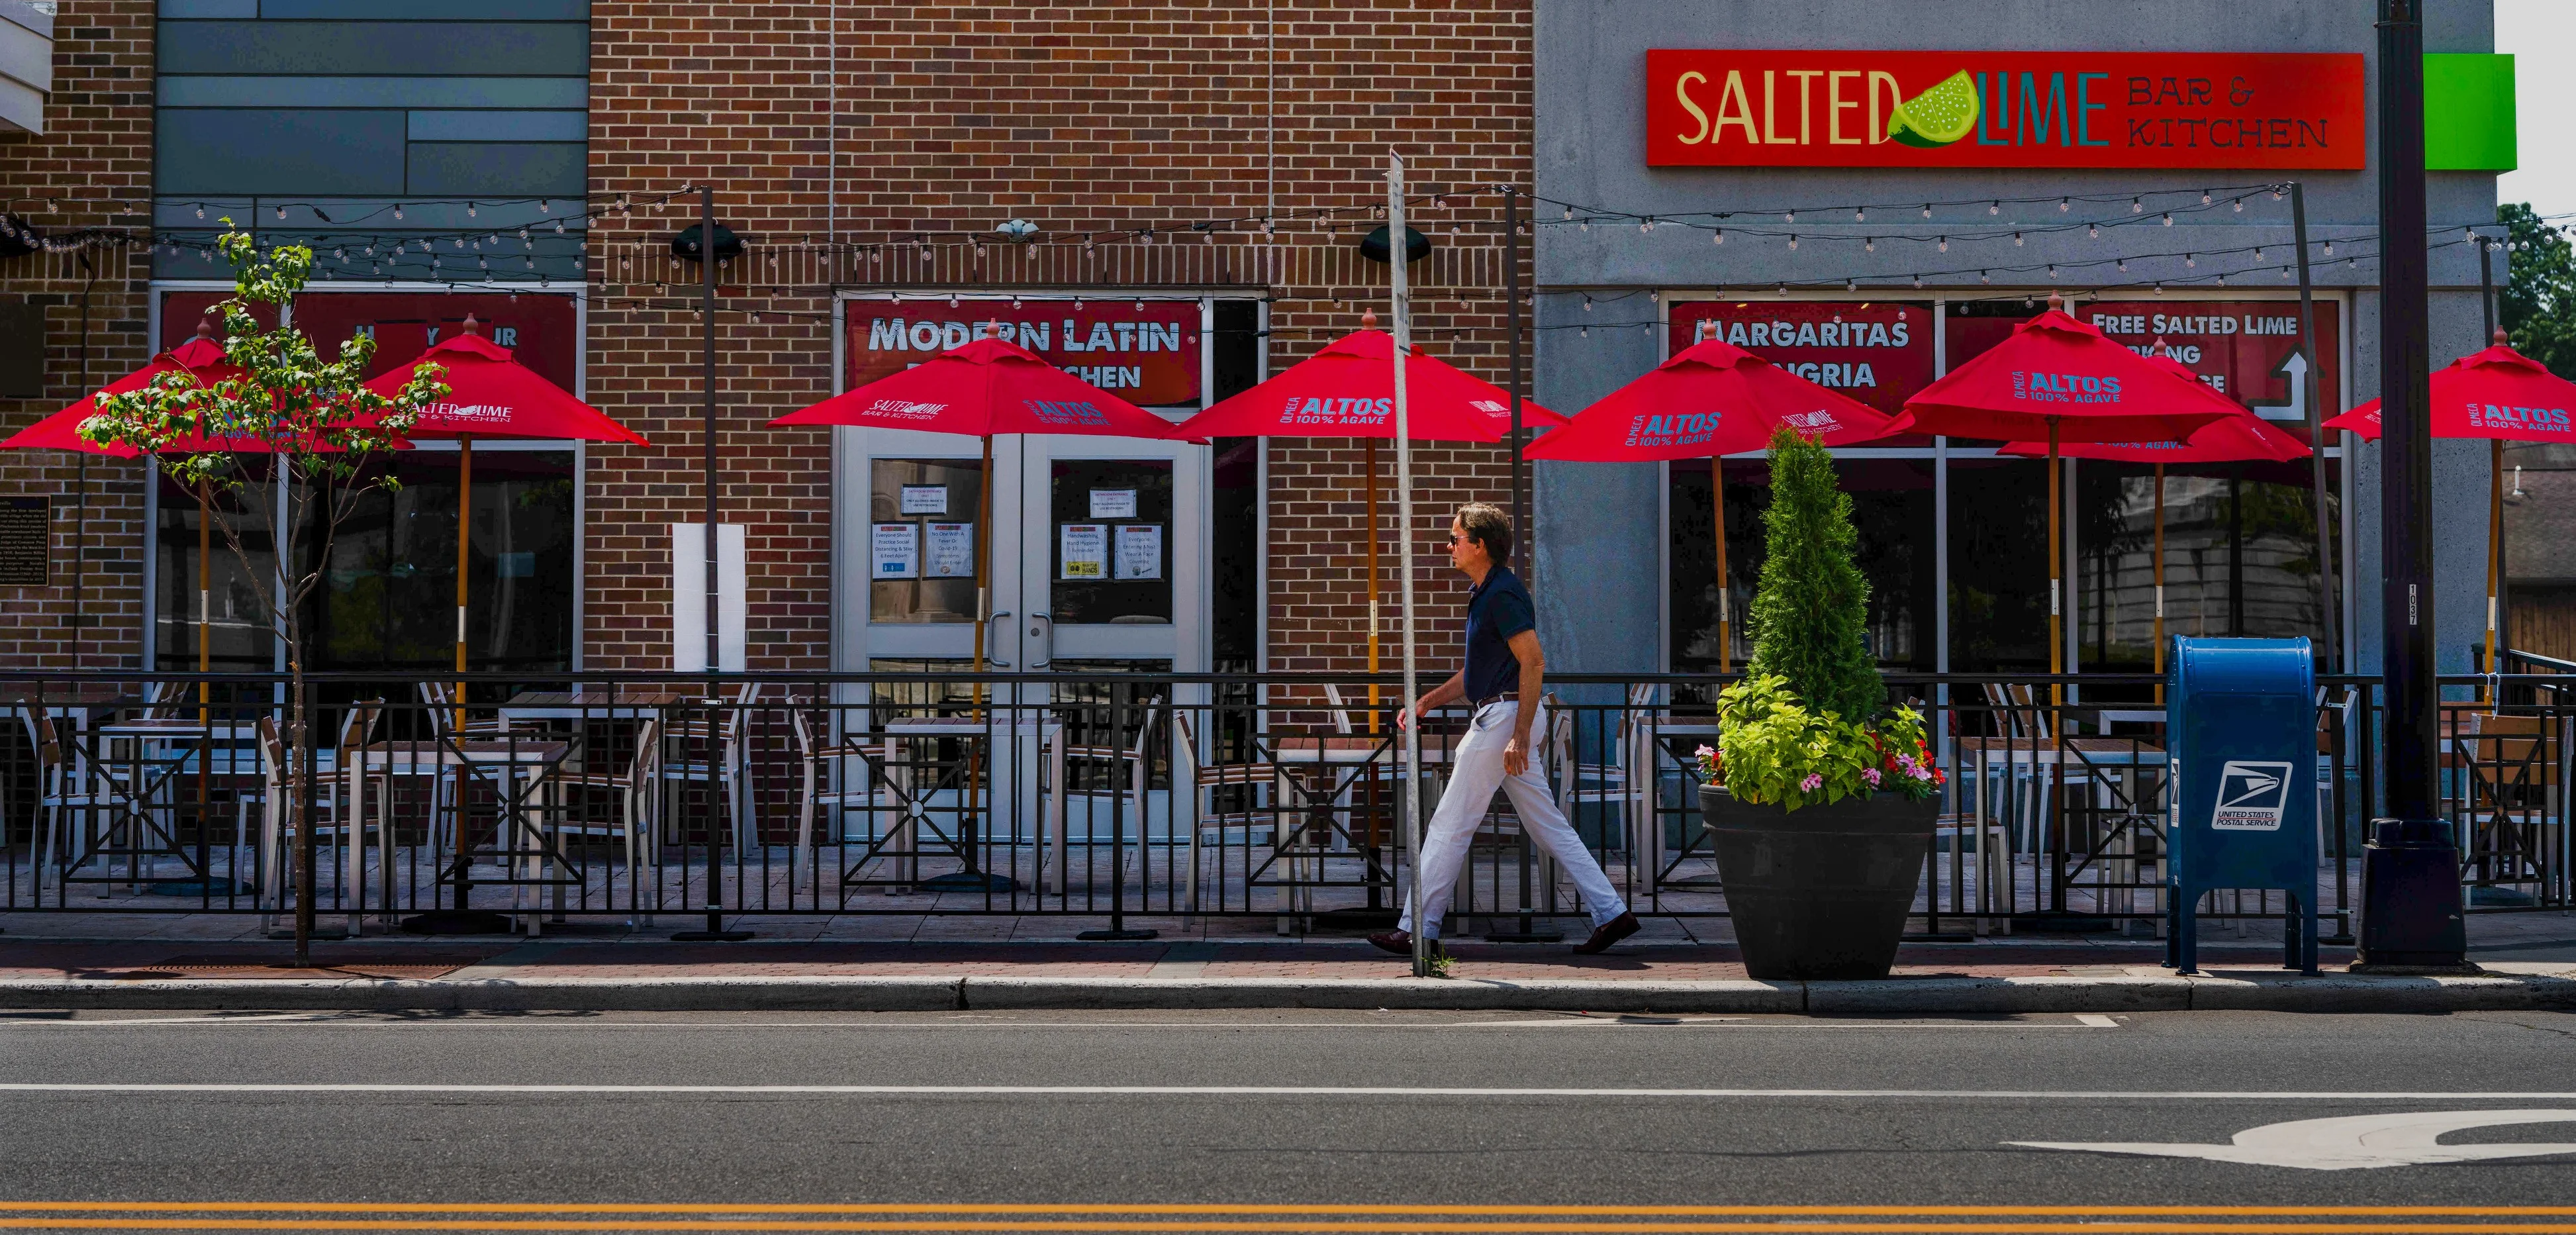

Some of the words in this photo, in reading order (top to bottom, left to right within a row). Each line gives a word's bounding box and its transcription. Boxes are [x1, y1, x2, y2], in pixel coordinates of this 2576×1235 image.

[2127, 77, 2213, 106] BAR
[2229, 76, 2254, 107] &
[1676, 70, 1901, 145] SALTED
[1976, 72, 2110, 147] LIME
[2127, 119, 2328, 148] KITCHEN
[2093, 314, 2145, 334] FREE
[2152, 314, 2238, 334] SALTED
[2244, 315, 2297, 334] LIME
[869, 318, 1049, 350] MODERN
[1063, 319, 1179, 352] LATIN
[2013, 371, 2027, 399] OLMECA
[2030, 372, 2122, 393] ALTOS
[869, 399, 914, 413] SALTED
[1300, 397, 1393, 416] ALTOS
[2030, 391, 2070, 403] 100%
[2075, 394, 2121, 403] AGAVE
[409, 401, 459, 414] ALTED
[476, 405, 513, 418] LIME
[1034, 400, 1104, 418] ALTOS
[1280, 397, 1301, 423] OLMECA
[2467, 403, 2483, 426] OLMECA
[2484, 404, 2571, 424] ALTOS
[1049, 417, 1078, 425] 100%
[1078, 417, 1112, 426] AGAVE
[1296, 415, 1335, 424] 100%
[1339, 416, 1385, 424] AGAVE
[1643, 411, 1723, 436] ALTOS
[2485, 420, 2523, 429] 100%
[2528, 422, 2571, 432] AGAVE
[1625, 415, 1646, 446] OLMECA
[1639, 436, 1672, 446] 100%
[1675, 432, 1713, 445] AGAVE
